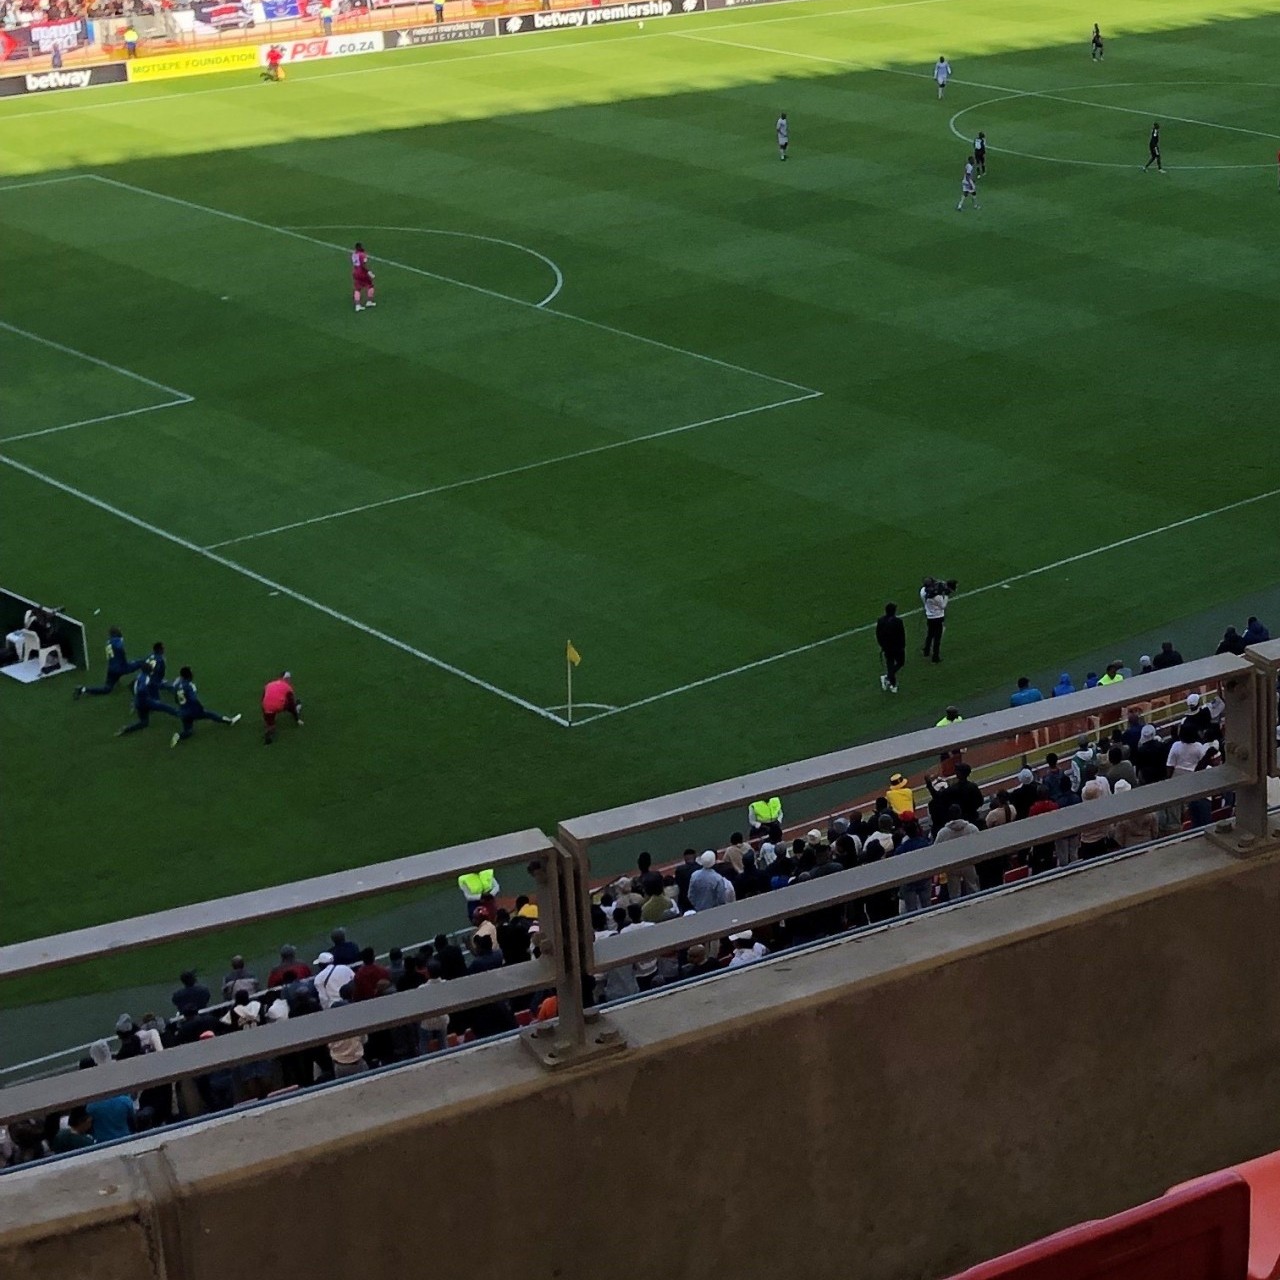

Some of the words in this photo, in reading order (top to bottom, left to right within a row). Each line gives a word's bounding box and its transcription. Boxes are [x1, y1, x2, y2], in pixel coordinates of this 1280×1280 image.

[534, 10, 586, 28] betway
[587, 0, 672, 25] premiership
[185, 53, 256, 70] FOUNDATION
[25, 69, 92, 91] betway
